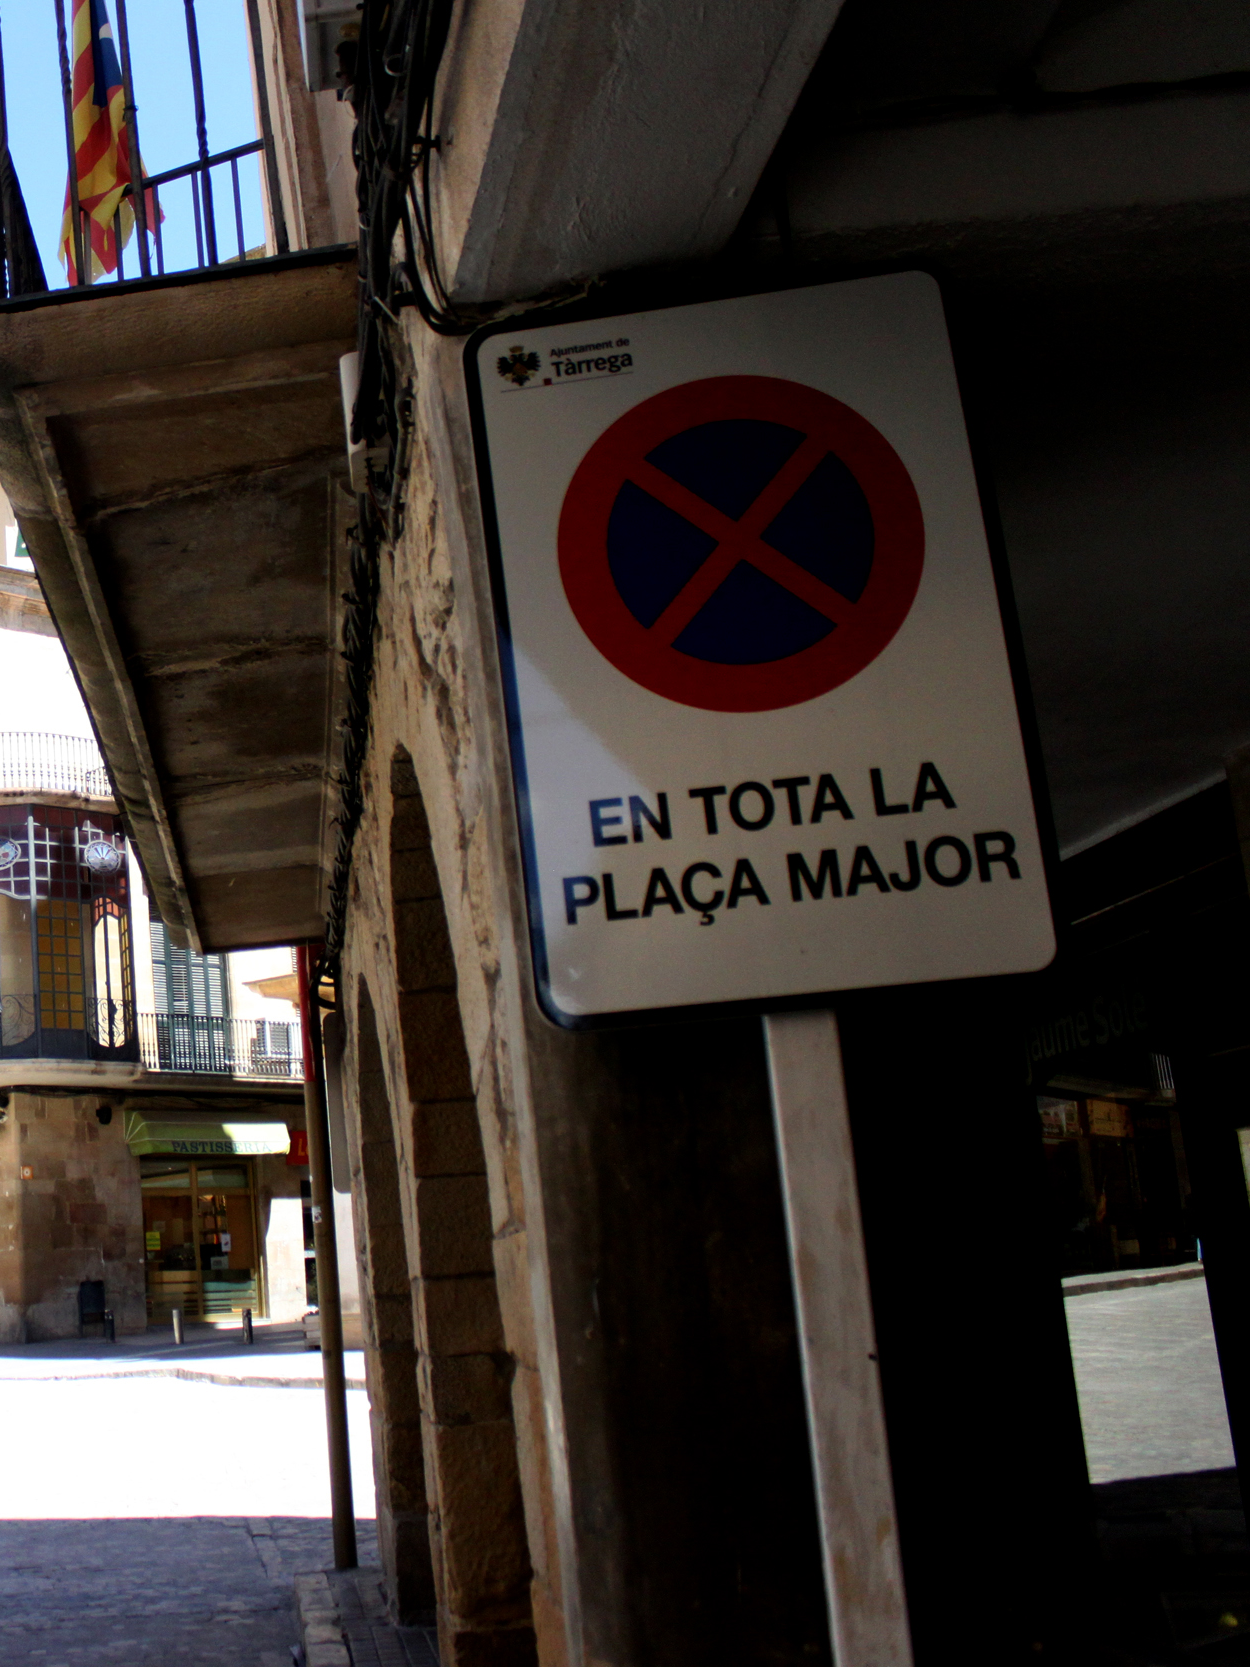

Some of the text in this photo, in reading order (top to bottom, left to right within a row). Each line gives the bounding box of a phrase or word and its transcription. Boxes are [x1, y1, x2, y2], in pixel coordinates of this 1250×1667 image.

[550, 337, 630, 358] Ajuntament de
[551, 353, 633, 377] Tàrrega
[589, 761, 957, 847] EN TOTA LA
[562, 830, 1021, 926] PLAÇA MAJOR
[171, 1140, 271, 1153] PASTISSERIA
